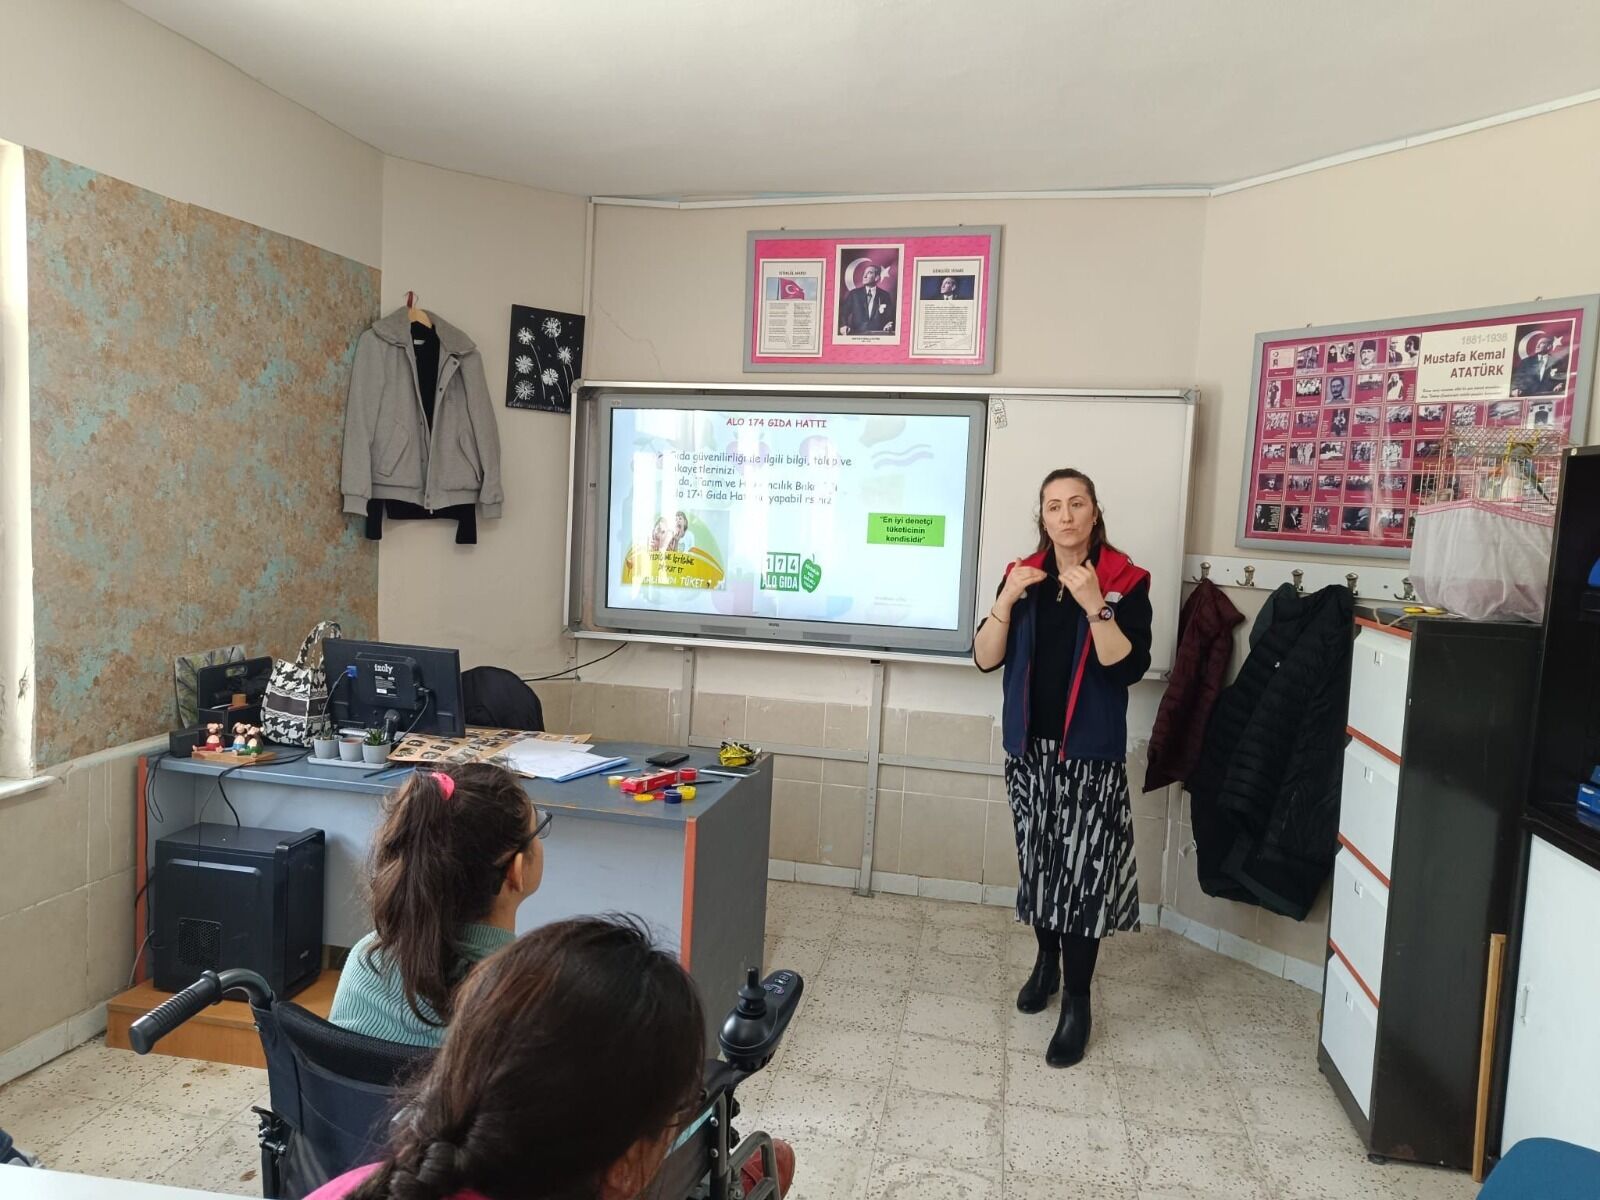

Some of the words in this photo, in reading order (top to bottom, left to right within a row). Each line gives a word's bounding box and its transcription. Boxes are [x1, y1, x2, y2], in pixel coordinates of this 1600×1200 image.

[1423, 351, 1466, 365] Mustafa
[1469, 347, 1506, 361] Kemal
[1450, 363, 1504, 378] ATATÜRK
[726, 417, 745, 426] ALO
[748, 418, 764, 427] 174
[767, 418, 792, 428] GIDA
[795, 419, 827, 428] HATTI
[786, 454, 810, 468] bilgi,
[840, 458, 852, 466] ve
[725, 480, 736, 488] ve
[906, 517, 933, 526] denetçi
[886, 526, 925, 534] tüketicinin
[779, 575, 798, 590] GIDA
